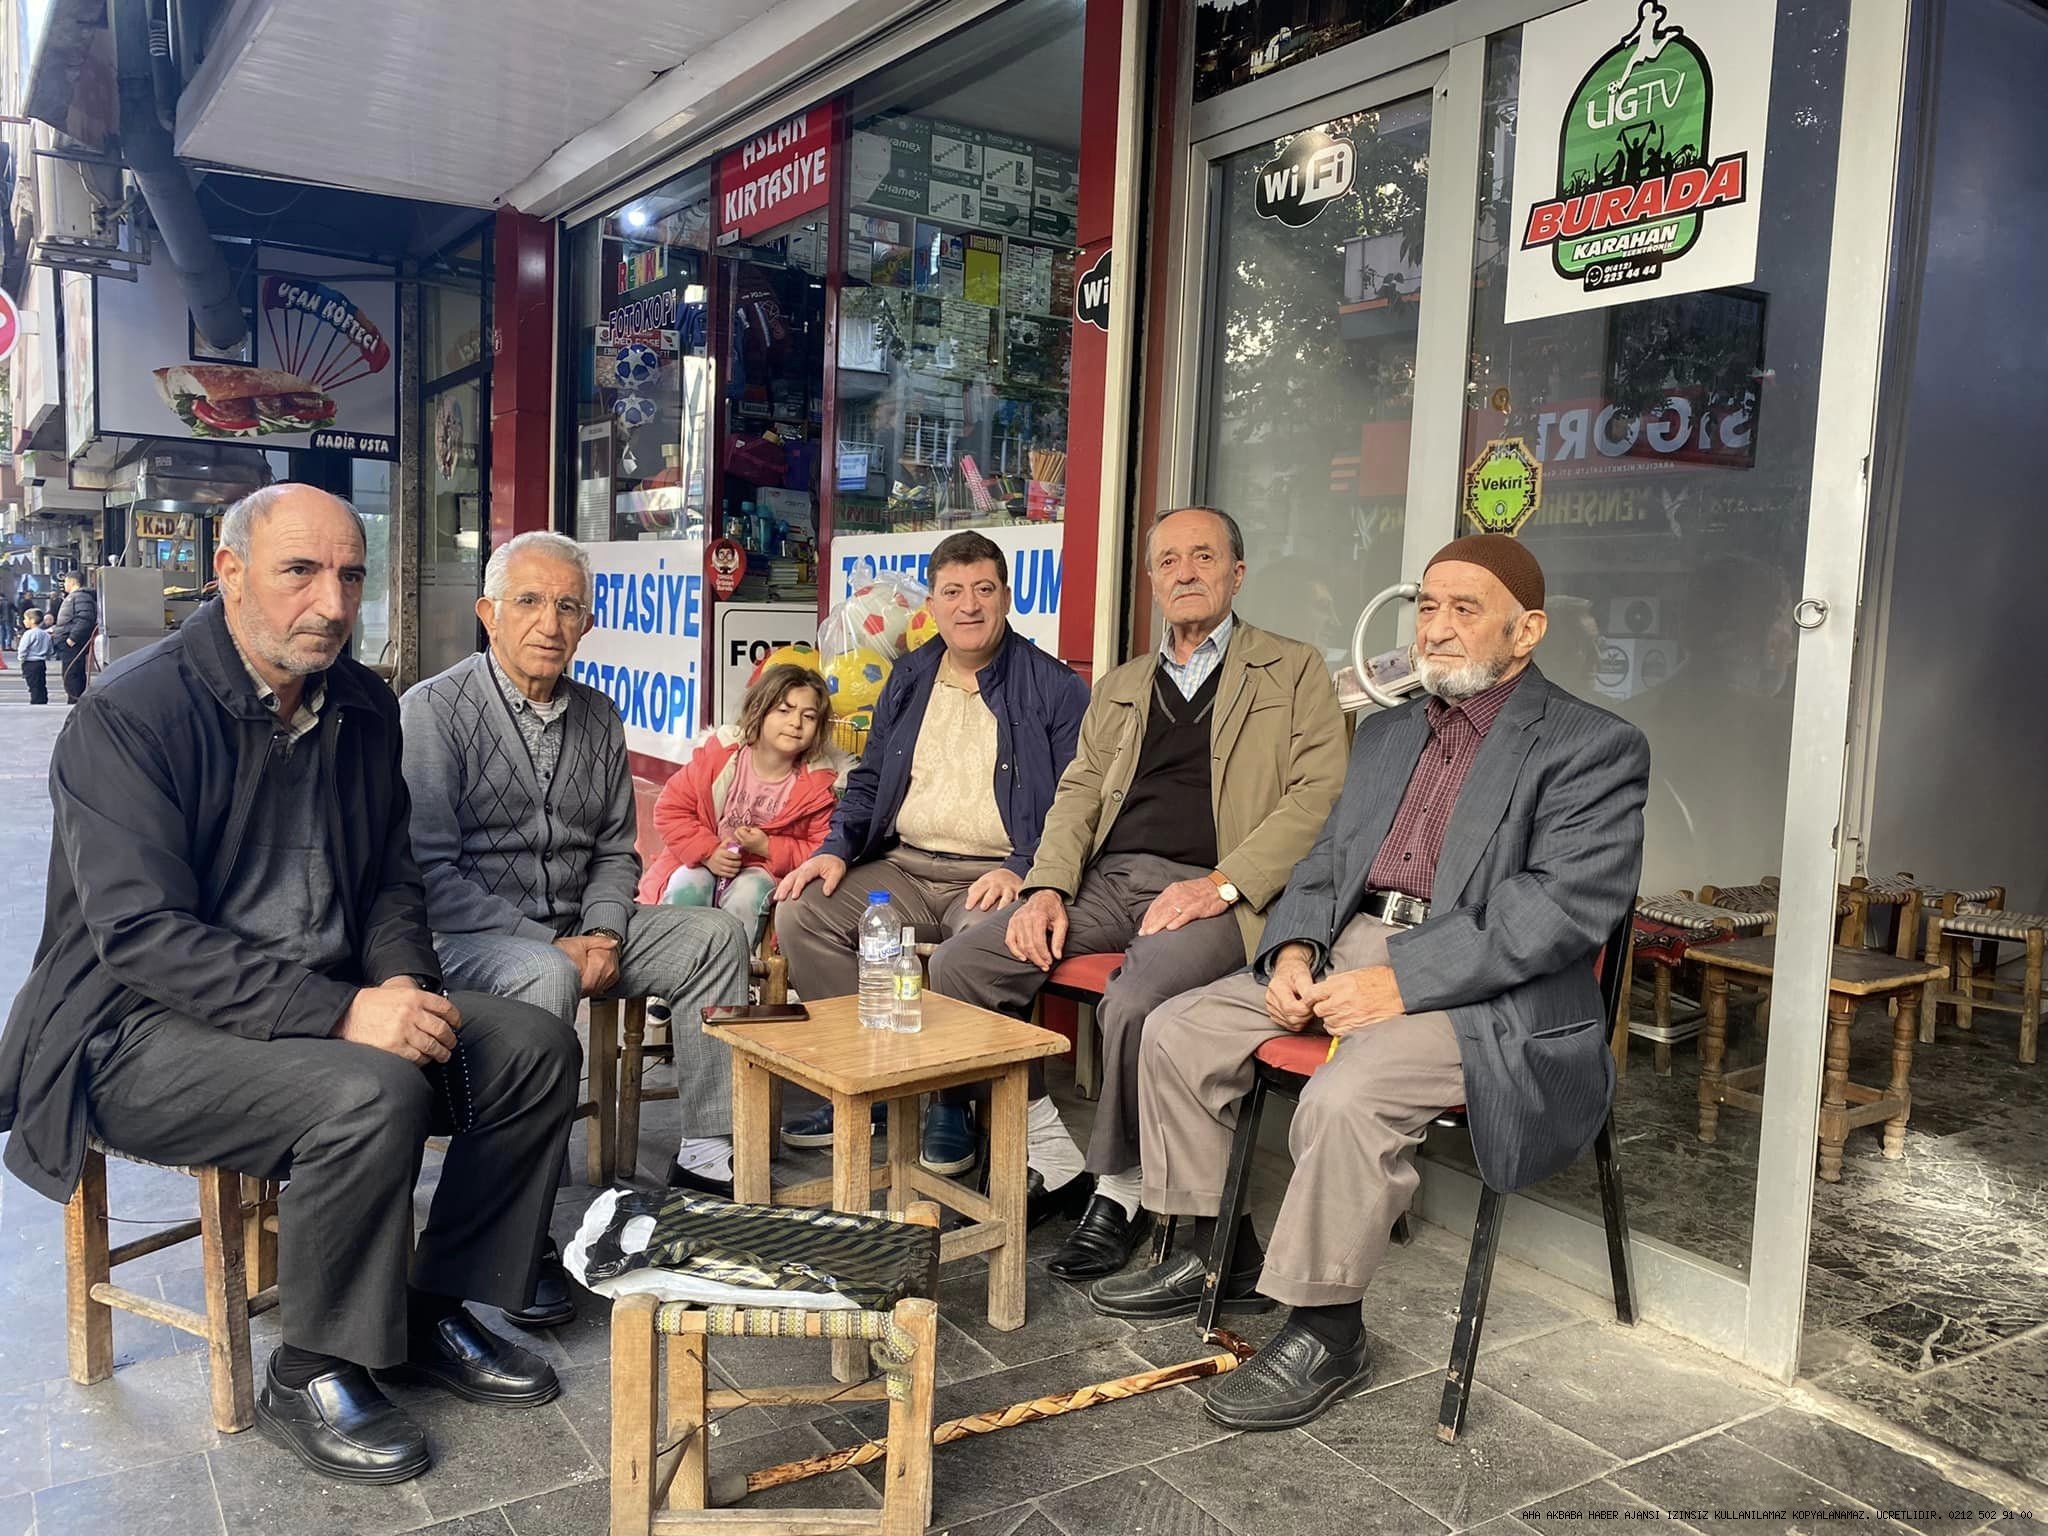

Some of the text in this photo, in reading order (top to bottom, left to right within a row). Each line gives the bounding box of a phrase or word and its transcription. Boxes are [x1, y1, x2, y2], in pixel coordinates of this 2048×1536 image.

[725, 147, 826, 225] KIRTASİYE
[1526, 159, 1742, 245] BURADA
[1573, 223, 1678, 260] KARAHAN
[1603, 264, 1657, 283] 223 44 44
[278, 282, 380, 351] UÇAN KÖFTECİ
[607, 288, 677, 341] FOTOKOPİ
[316, 432, 389, 453] KADİR USTA
[1481, 474, 1522, 490] Vekiri
[593, 558, 701, 638] RTASİYE
[1013, 548, 1064, 615] UM
[731, 639, 811, 666] FO
